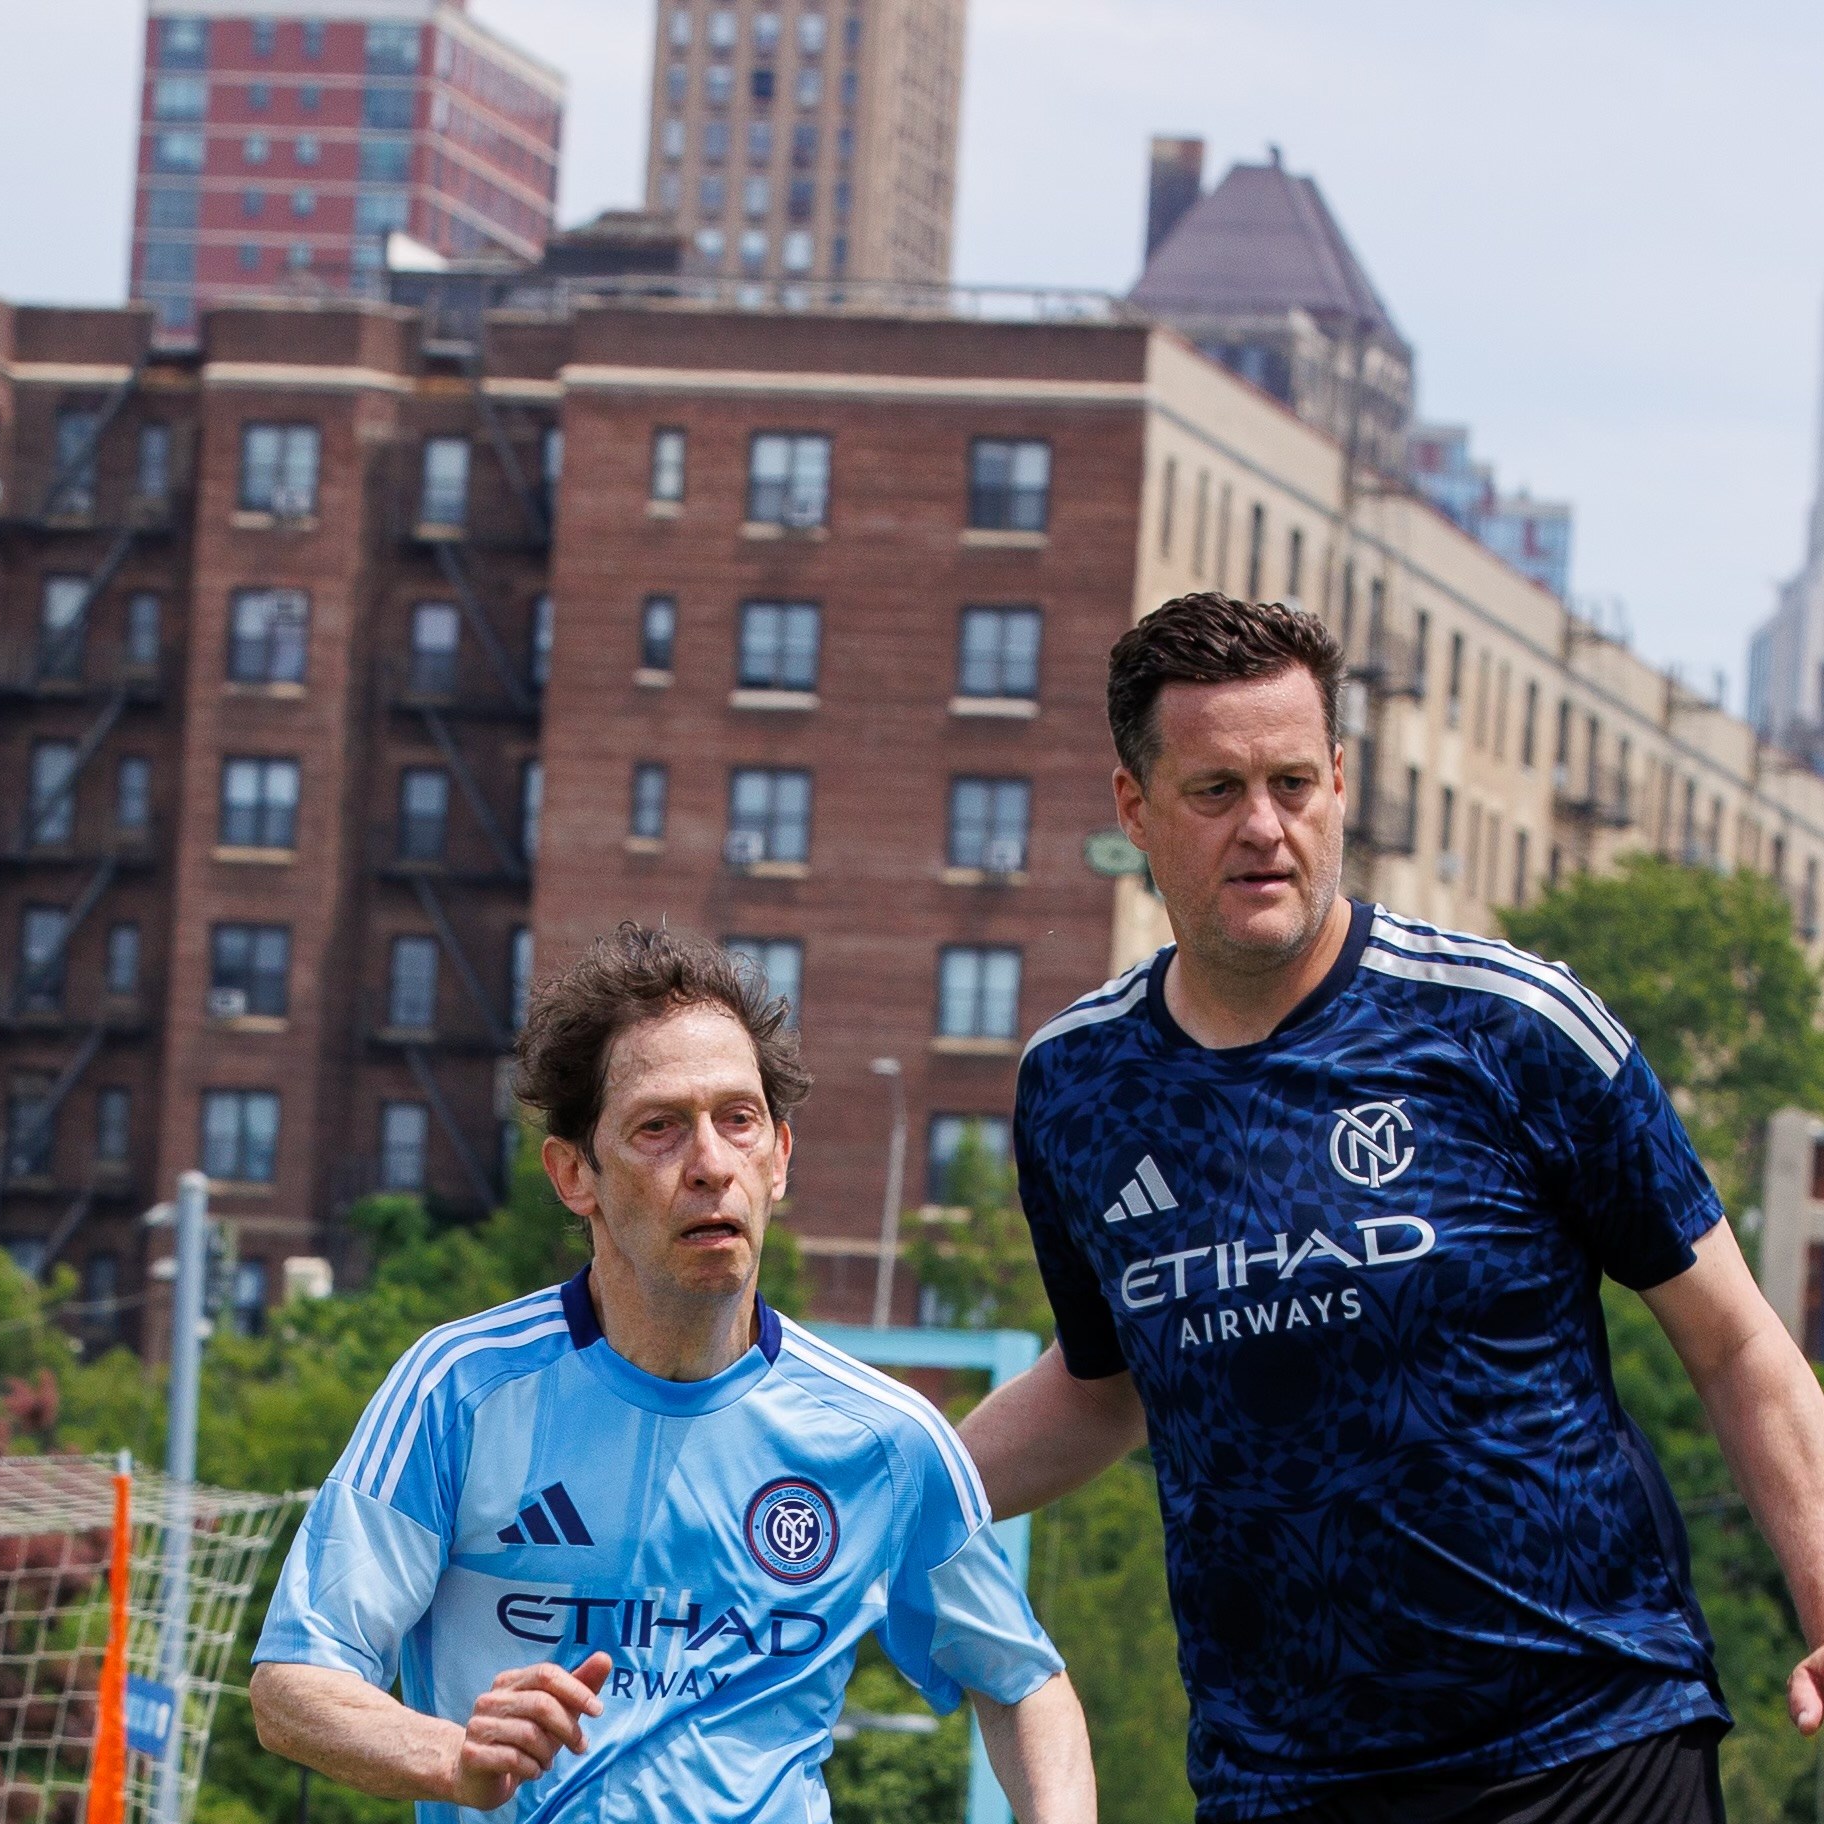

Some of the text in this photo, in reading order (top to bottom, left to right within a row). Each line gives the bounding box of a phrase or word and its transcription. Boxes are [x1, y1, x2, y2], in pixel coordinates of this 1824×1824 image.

[1121, 1214, 1436, 1309] ETIHAD
[1180, 1287, 1363, 1349] AIRWAYS
[764, 1491, 783, 1505] NEW
[806, 1492, 824, 1509] CITY
[496, 1592, 829, 1658] ETIHAD
